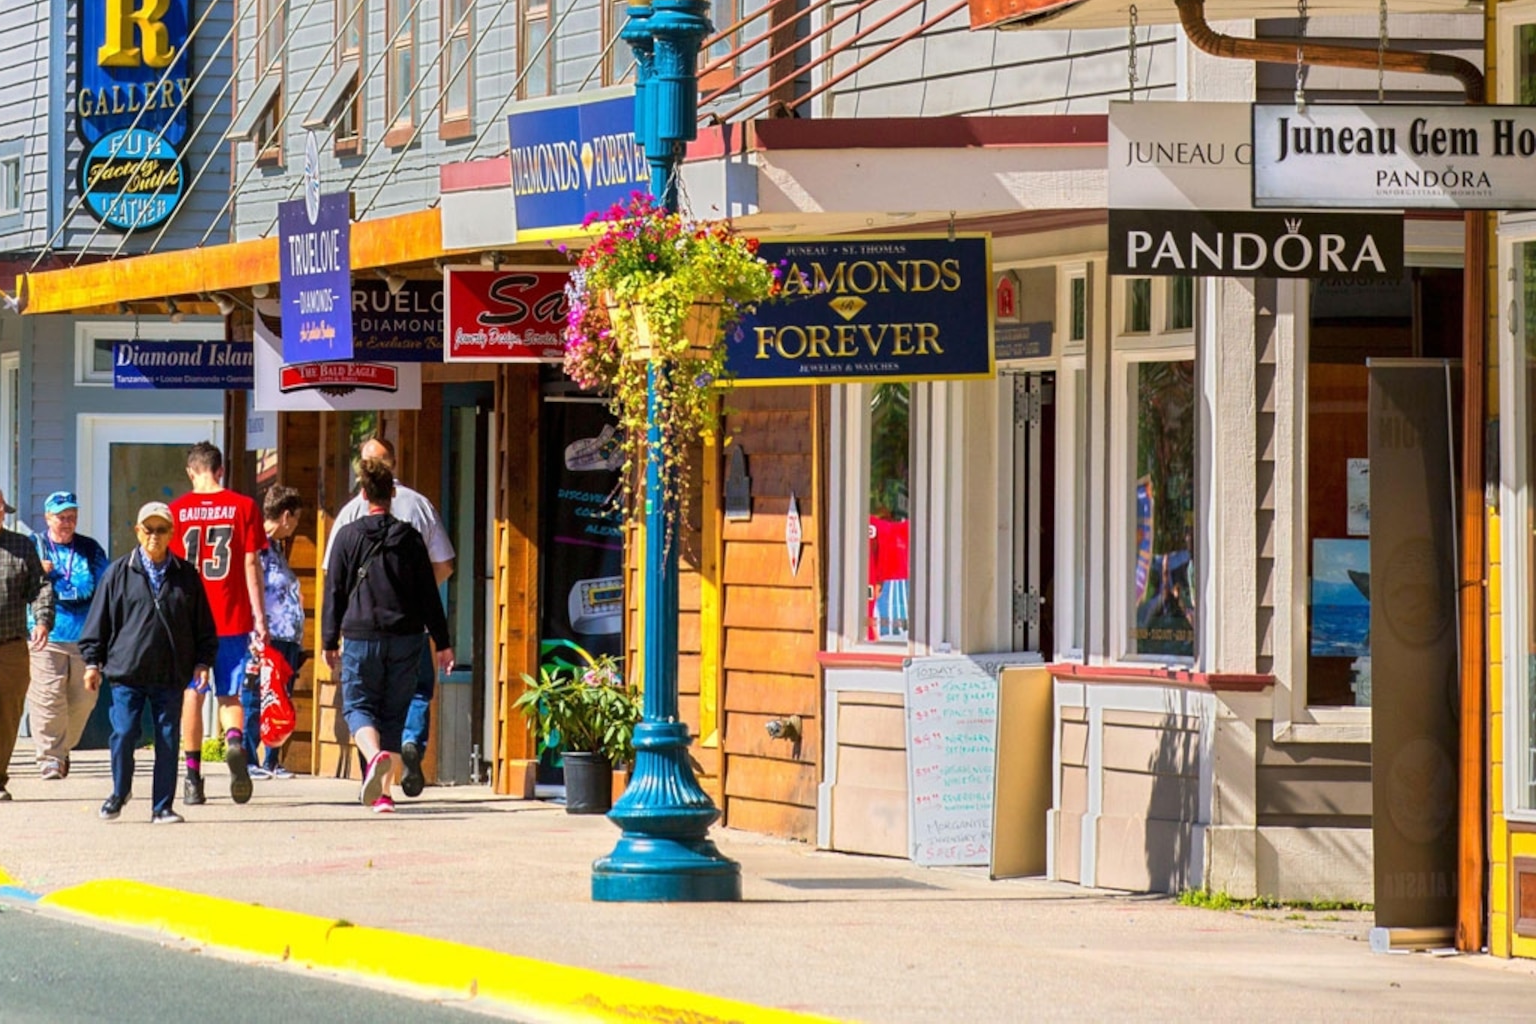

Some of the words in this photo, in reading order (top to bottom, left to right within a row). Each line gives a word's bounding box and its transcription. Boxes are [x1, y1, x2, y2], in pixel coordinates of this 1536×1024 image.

[78, 78, 192, 118] GALLERY
[1126, 141, 1225, 168] JUNEAU
[1275, 117, 1397, 163] Juneau
[1409, 117, 1479, 157] Gem
[512, 139, 580, 197] DIAMONDS
[1376, 169, 1492, 189] PANDORA
[288, 229, 341, 276] TRUELOVE
[1127, 229, 1387, 274] PANDORA
[780, 258, 962, 296] AMONDS
[351, 290, 444, 313] RUELO
[361, 318, 444, 333] DIAMOND
[753, 322, 945, 360] FOREVER
[116, 343, 204, 367] Diamond
[208, 343, 253, 367] Islan
[178, 505, 237, 522] GAUDREAU
[182, 524, 235, 581] 13
